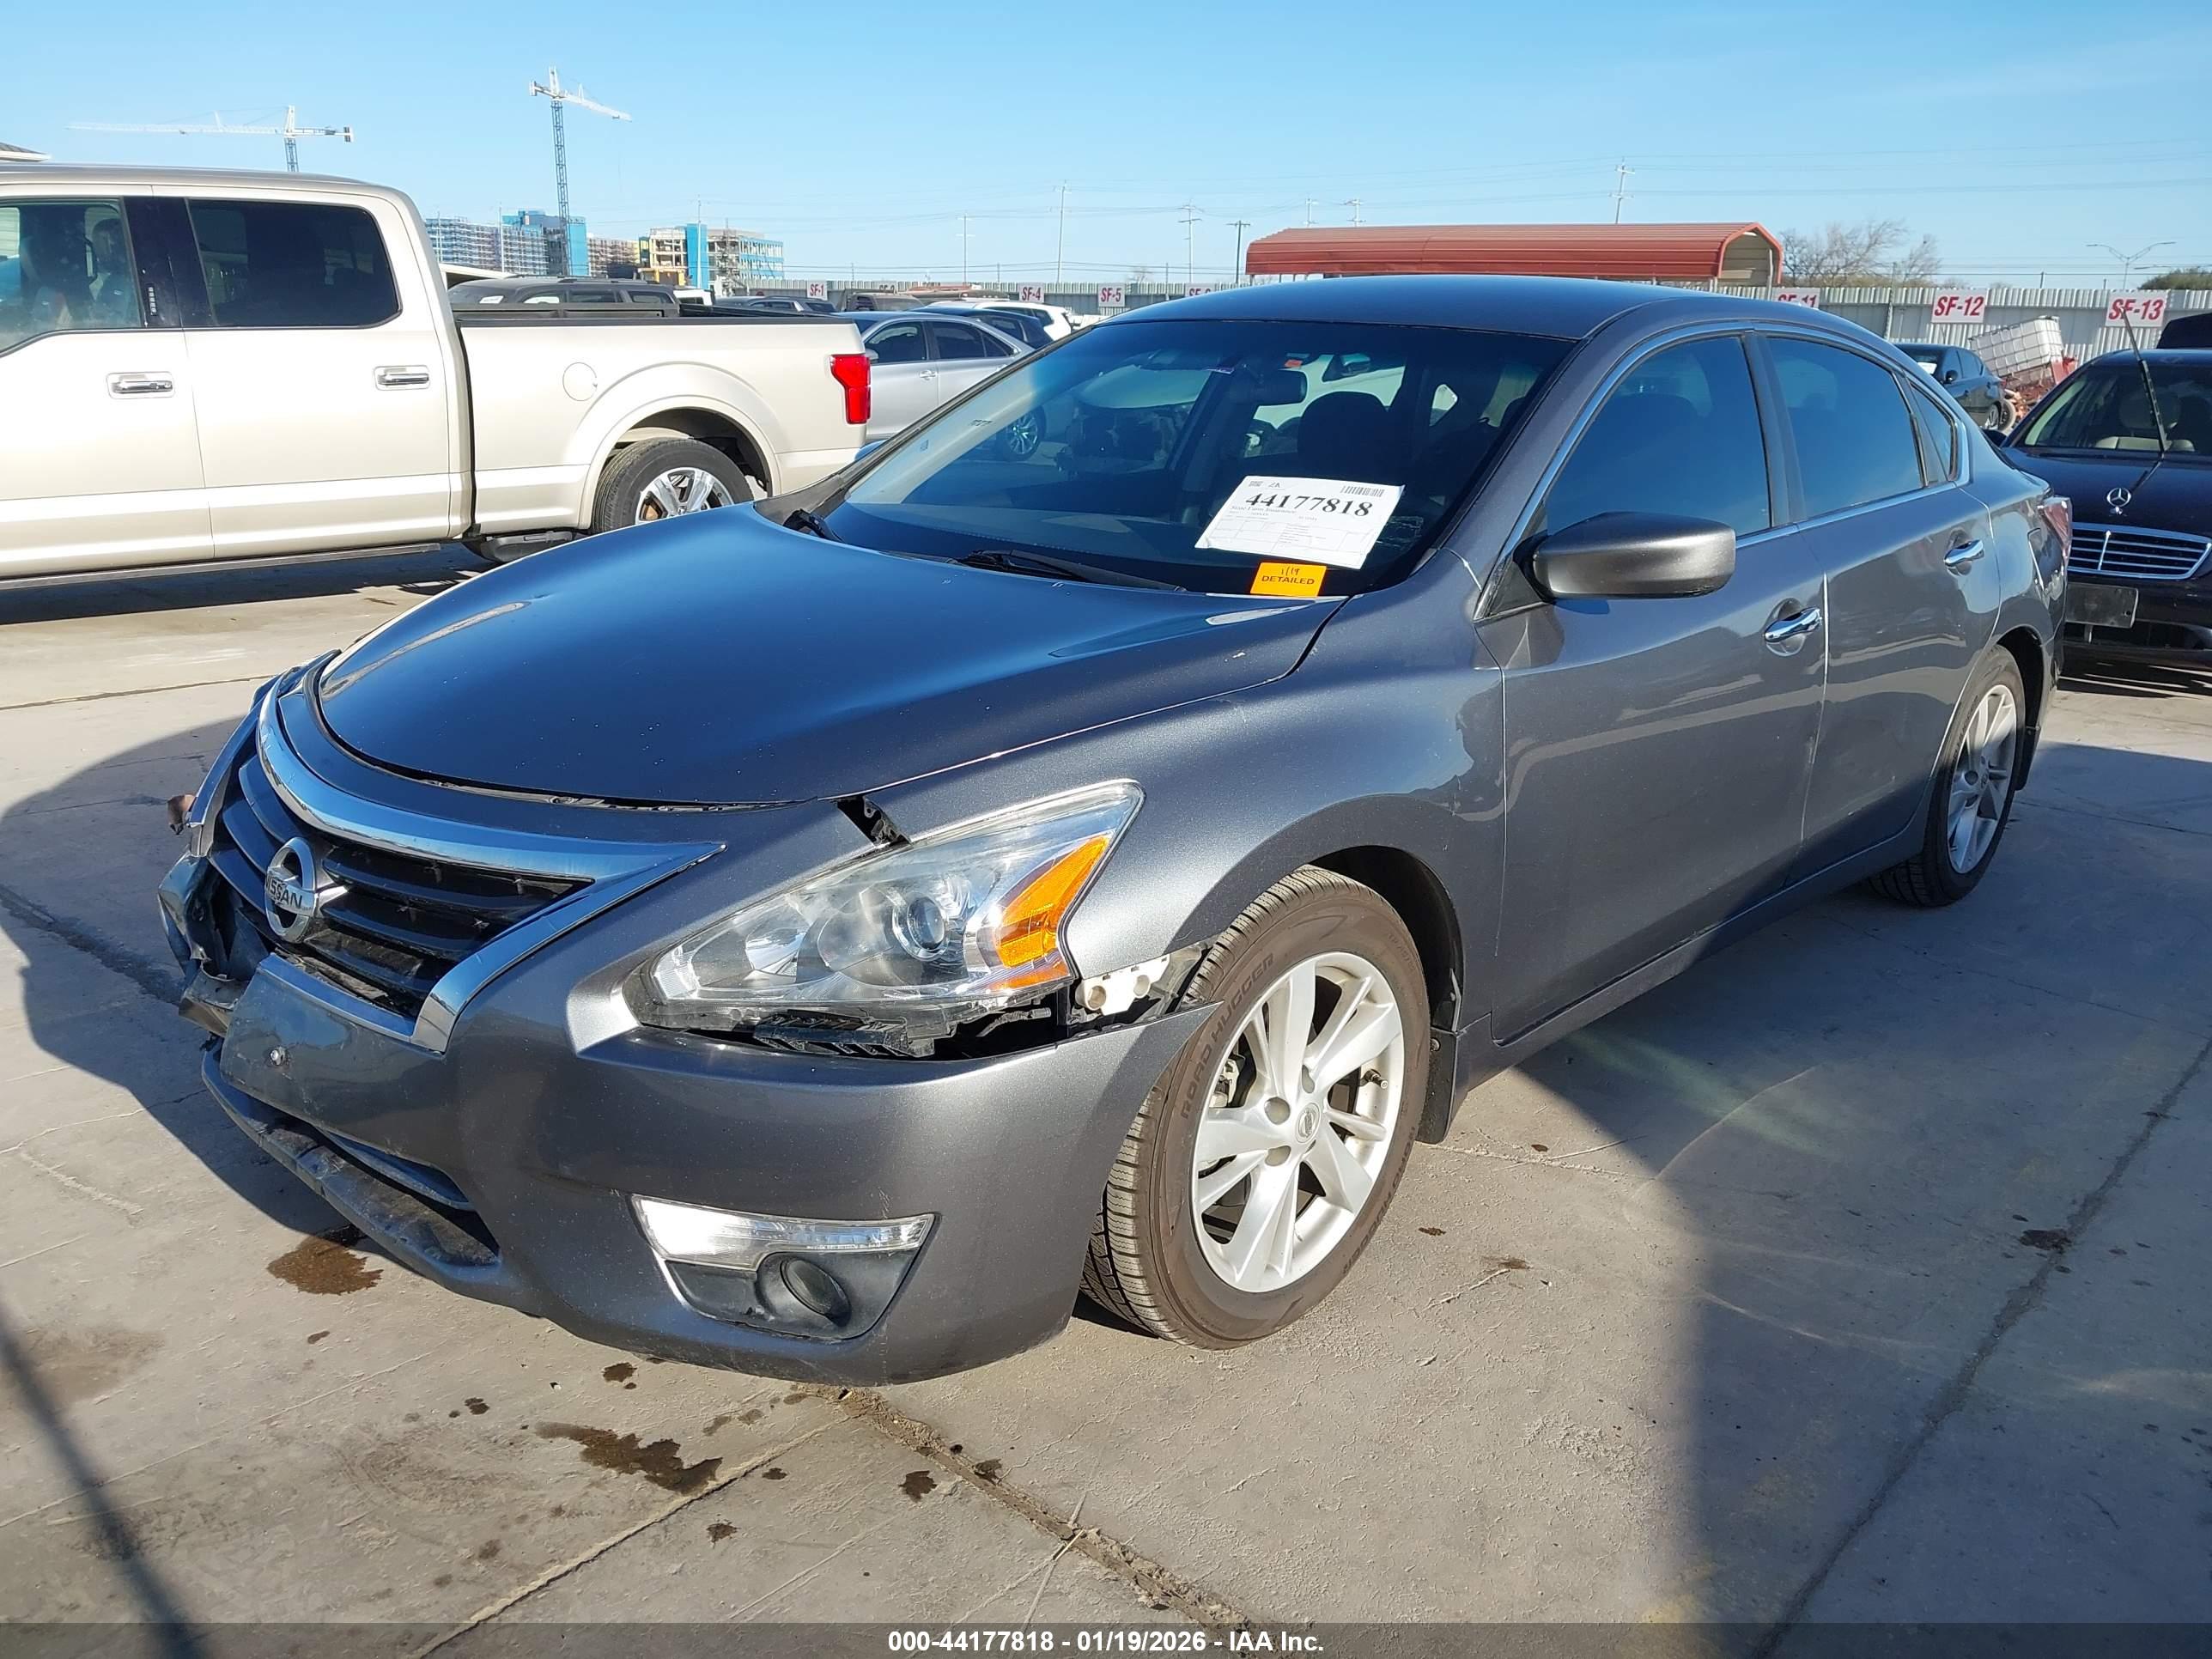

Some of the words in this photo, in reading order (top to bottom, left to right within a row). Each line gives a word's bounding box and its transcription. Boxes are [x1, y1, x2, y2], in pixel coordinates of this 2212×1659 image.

[810, 283, 824, 296] SF-1
[1022, 287, 1042, 301] SF-4
[1100, 288, 1121, 302] SF-5
[1935, 296, 1984, 316] SF-12
[2108, 299, 2164, 320] SF-13
[1245, 493, 1373, 517] 44177818
[1261, 575, 1315, 585] DETAILED
[1181, 1042, 1212, 1120] ROAD
[1211, 952, 1274, 1042] HUGGER
